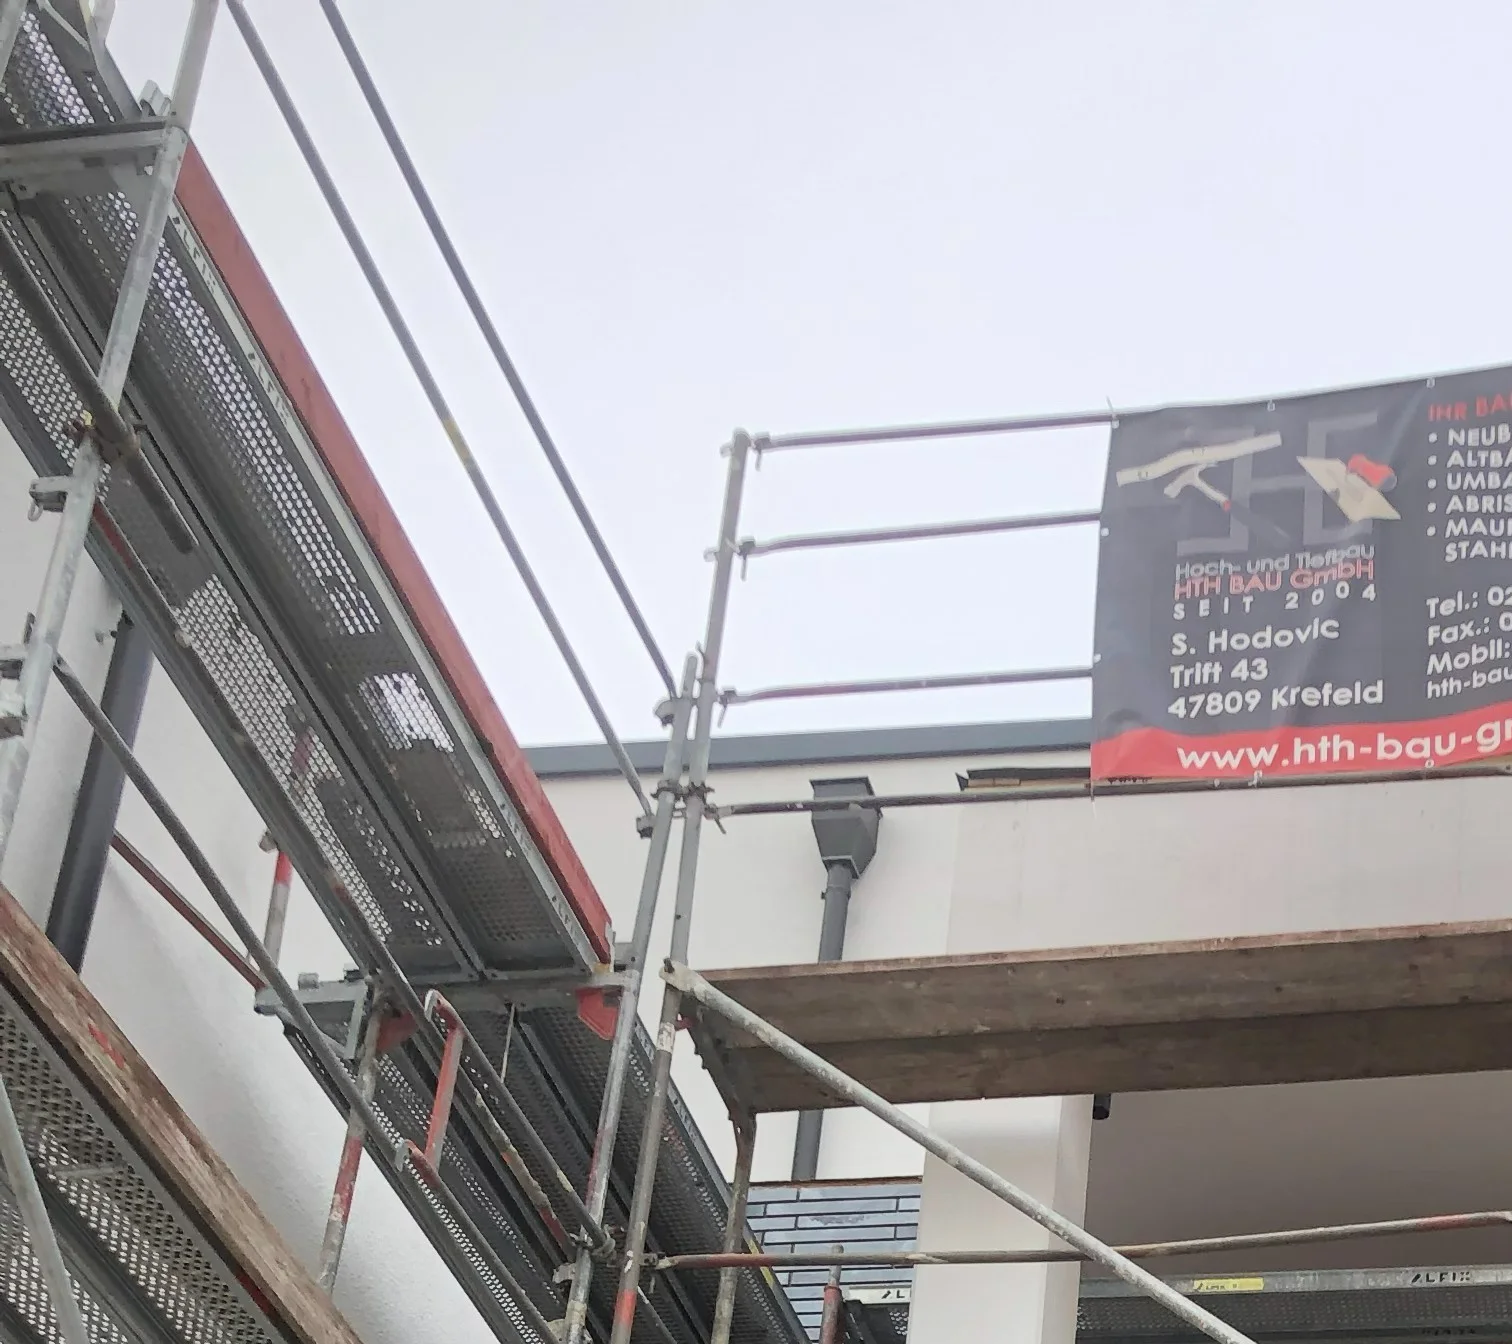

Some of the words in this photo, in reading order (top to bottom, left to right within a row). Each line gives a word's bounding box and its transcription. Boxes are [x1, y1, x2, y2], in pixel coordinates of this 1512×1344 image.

[1428, 402, 1467, 422] IHR
[1174, 575, 1221, 600] HTH
[1229, 571, 1282, 595] BAU
[1290, 559, 1375, 590] GmbH
[1175, 560, 1241, 581] Hoch-
[1246, 553, 1290, 574] und
[1425, 592, 1479, 619] Tel.:
[1171, 632, 1196, 656] S.
[1208, 617, 1341, 654] Hodovic
[1427, 617, 1491, 646] Fax.:
[1426, 639, 1511, 675] Mobil:
[1170, 661, 1223, 689] Trift
[1230, 657, 1269, 683] 43
[1167, 688, 1262, 719] 47809
[1271, 680, 1384, 711] Krefeld
[1411, 1271, 1471, 1284] ALFIX
